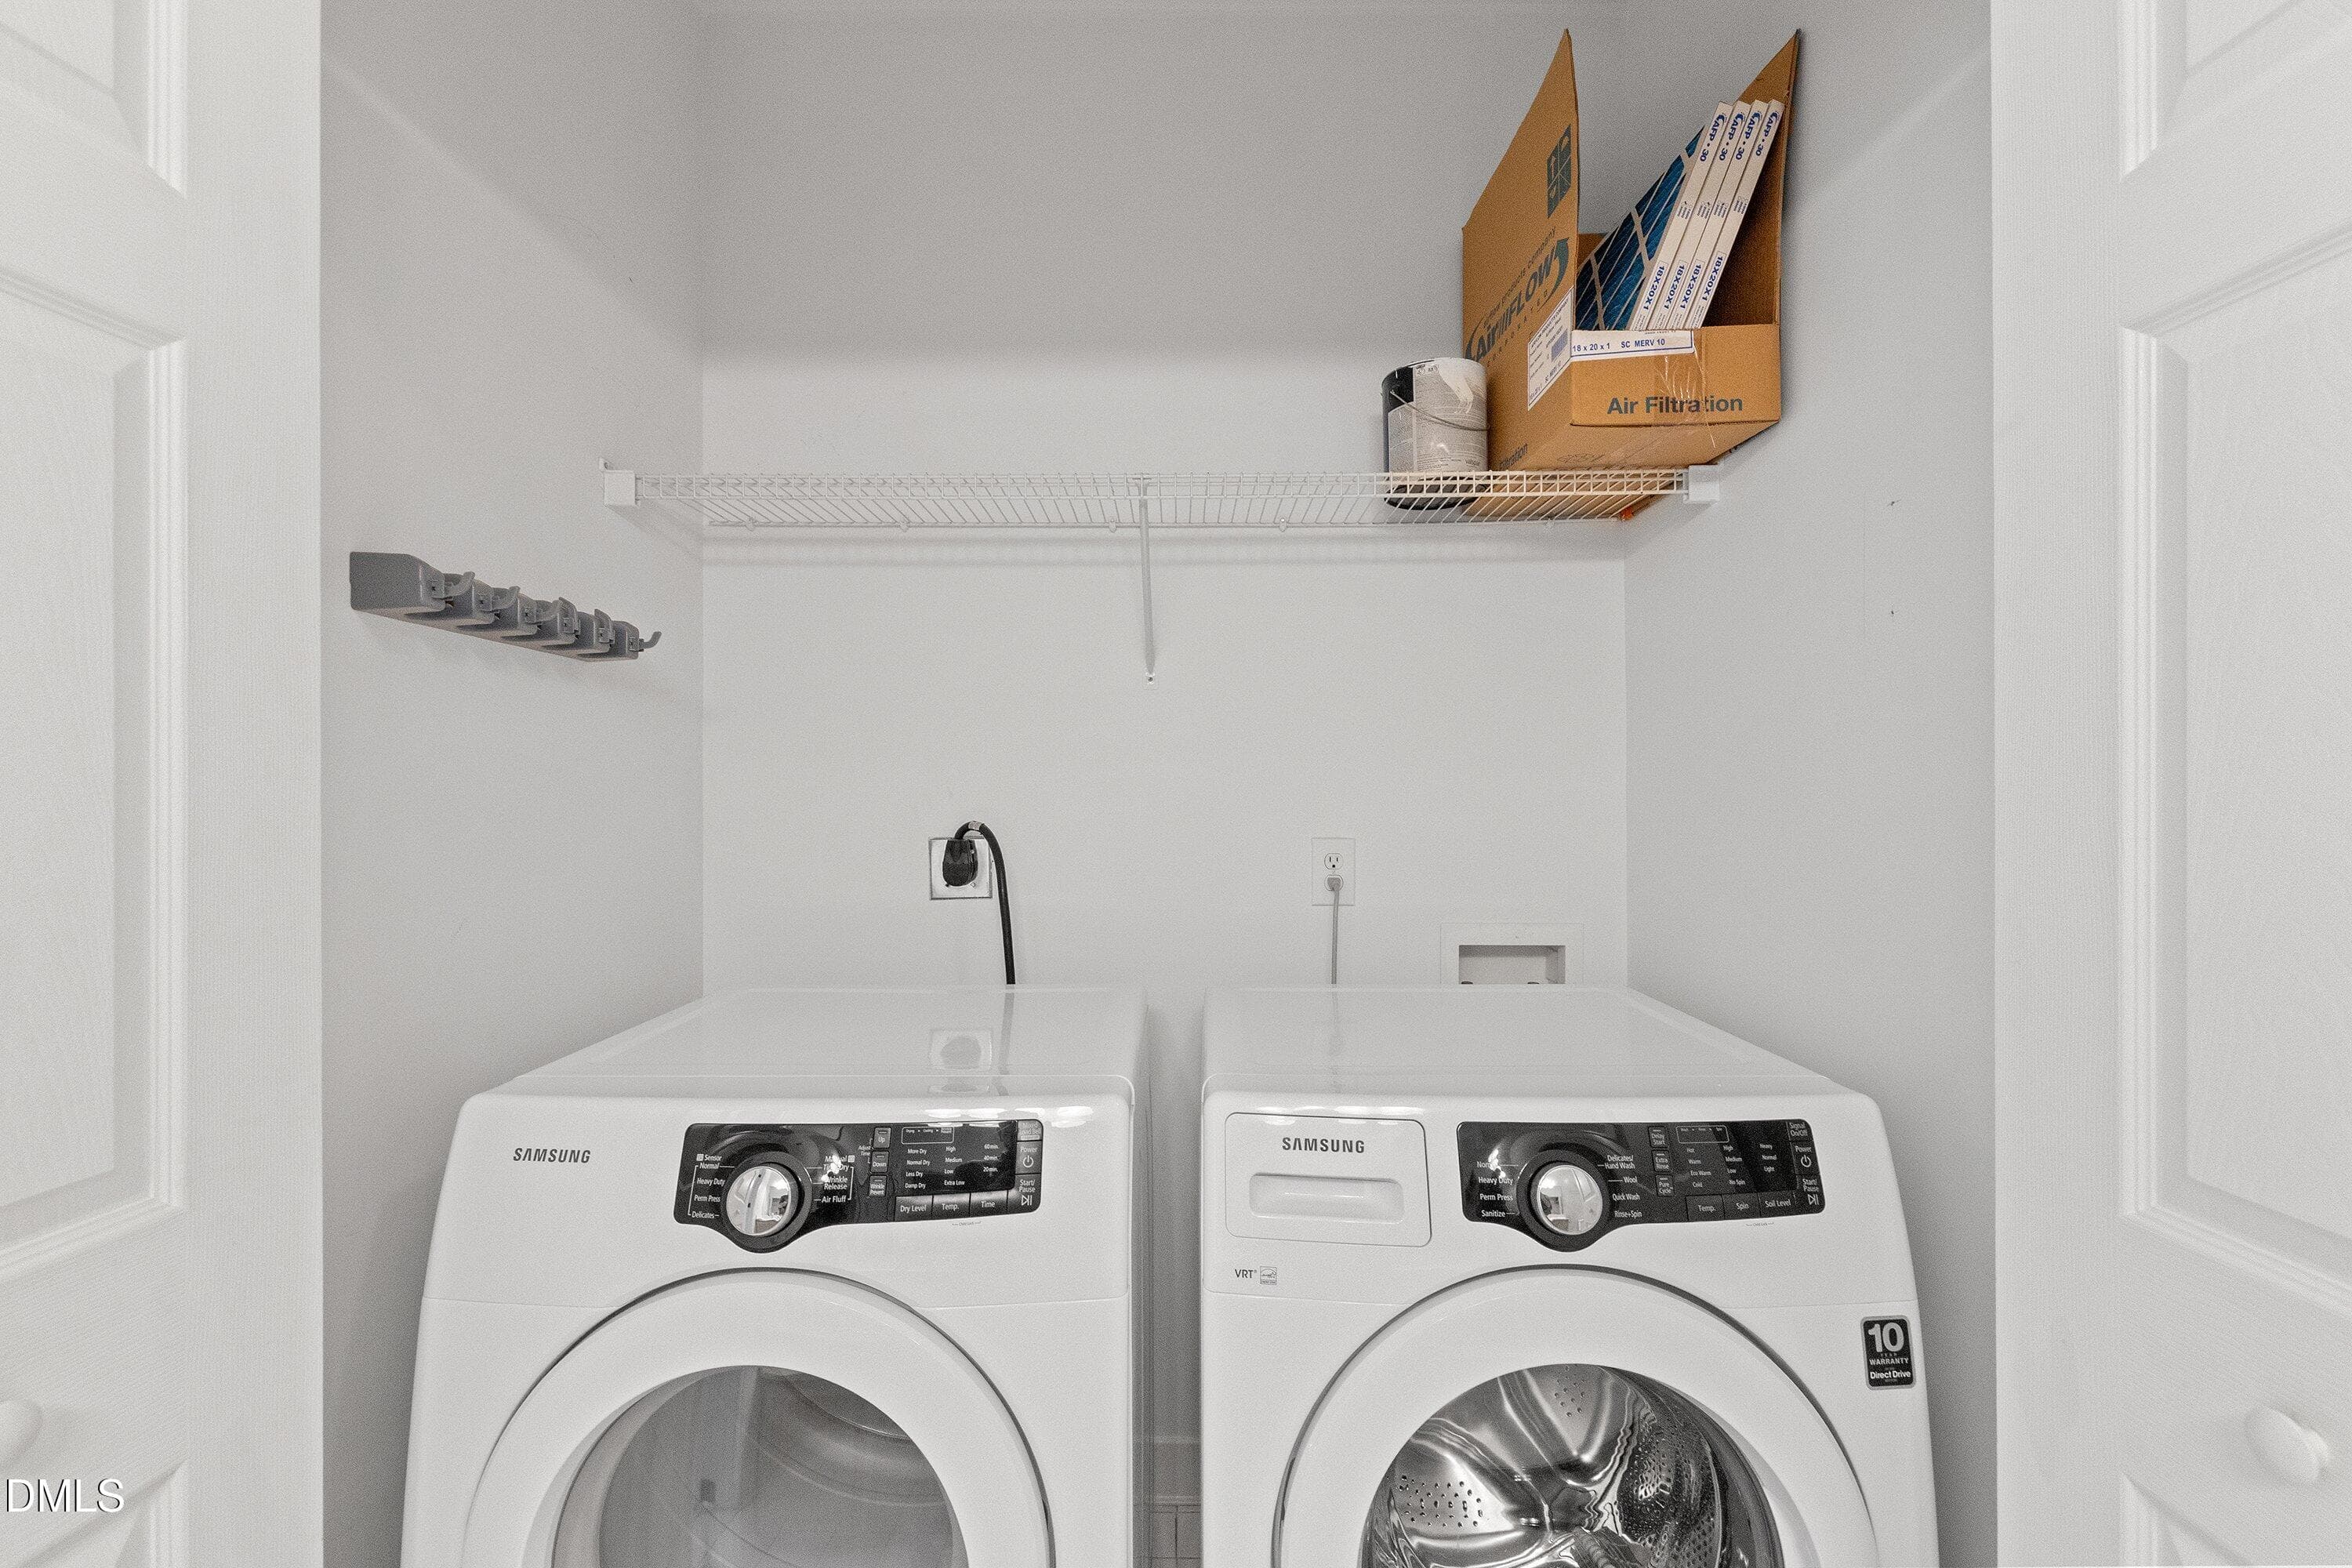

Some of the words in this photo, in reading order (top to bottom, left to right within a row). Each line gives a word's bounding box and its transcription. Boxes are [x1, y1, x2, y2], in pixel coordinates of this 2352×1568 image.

[1700, 148, 1709, 162] 30
[1719, 147, 1728, 161] 30
[1736, 147, 1744, 160] 30
[1755, 143, 1764, 156] 30
[1702, 256, 1723, 301] 18X20X1
[1643, 266, 1665, 310] 18X20X1
[1664, 264, 1685, 309] 18X20X1
[1680, 263, 1701, 309] 18X20X1
[1589, 343, 1599, 351] 20
[1634, 339, 1654, 347] MERV
[1656, 337, 1665, 346] 10
[1607, 397, 1639, 415] Air
[1645, 395, 1744, 414] Filtration
[1281, 1136, 1366, 1153] SAMSUNG
[513, 1147, 591, 1163] SAMSUNG
[696, 1178, 713, 1186] Heavy
[713, 1178, 726, 1187] Duty
[1478, 1176, 1497, 1185] Heavy
[1498, 1177, 1513, 1185] Duty
[900, 1205, 910, 1214] Dry
[1736, 1202, 1749, 1210] Spin
[1777, 1199, 1791, 1207] Level
[691, 1210, 715, 1219] Delicates
[1867, 1322, 1904, 1352] 10
[1869, 1357, 1910, 1366] WARRANTY
[1870, 1370, 1892, 1380] Direct
[1892, 1370, 1912, 1378] Drive
